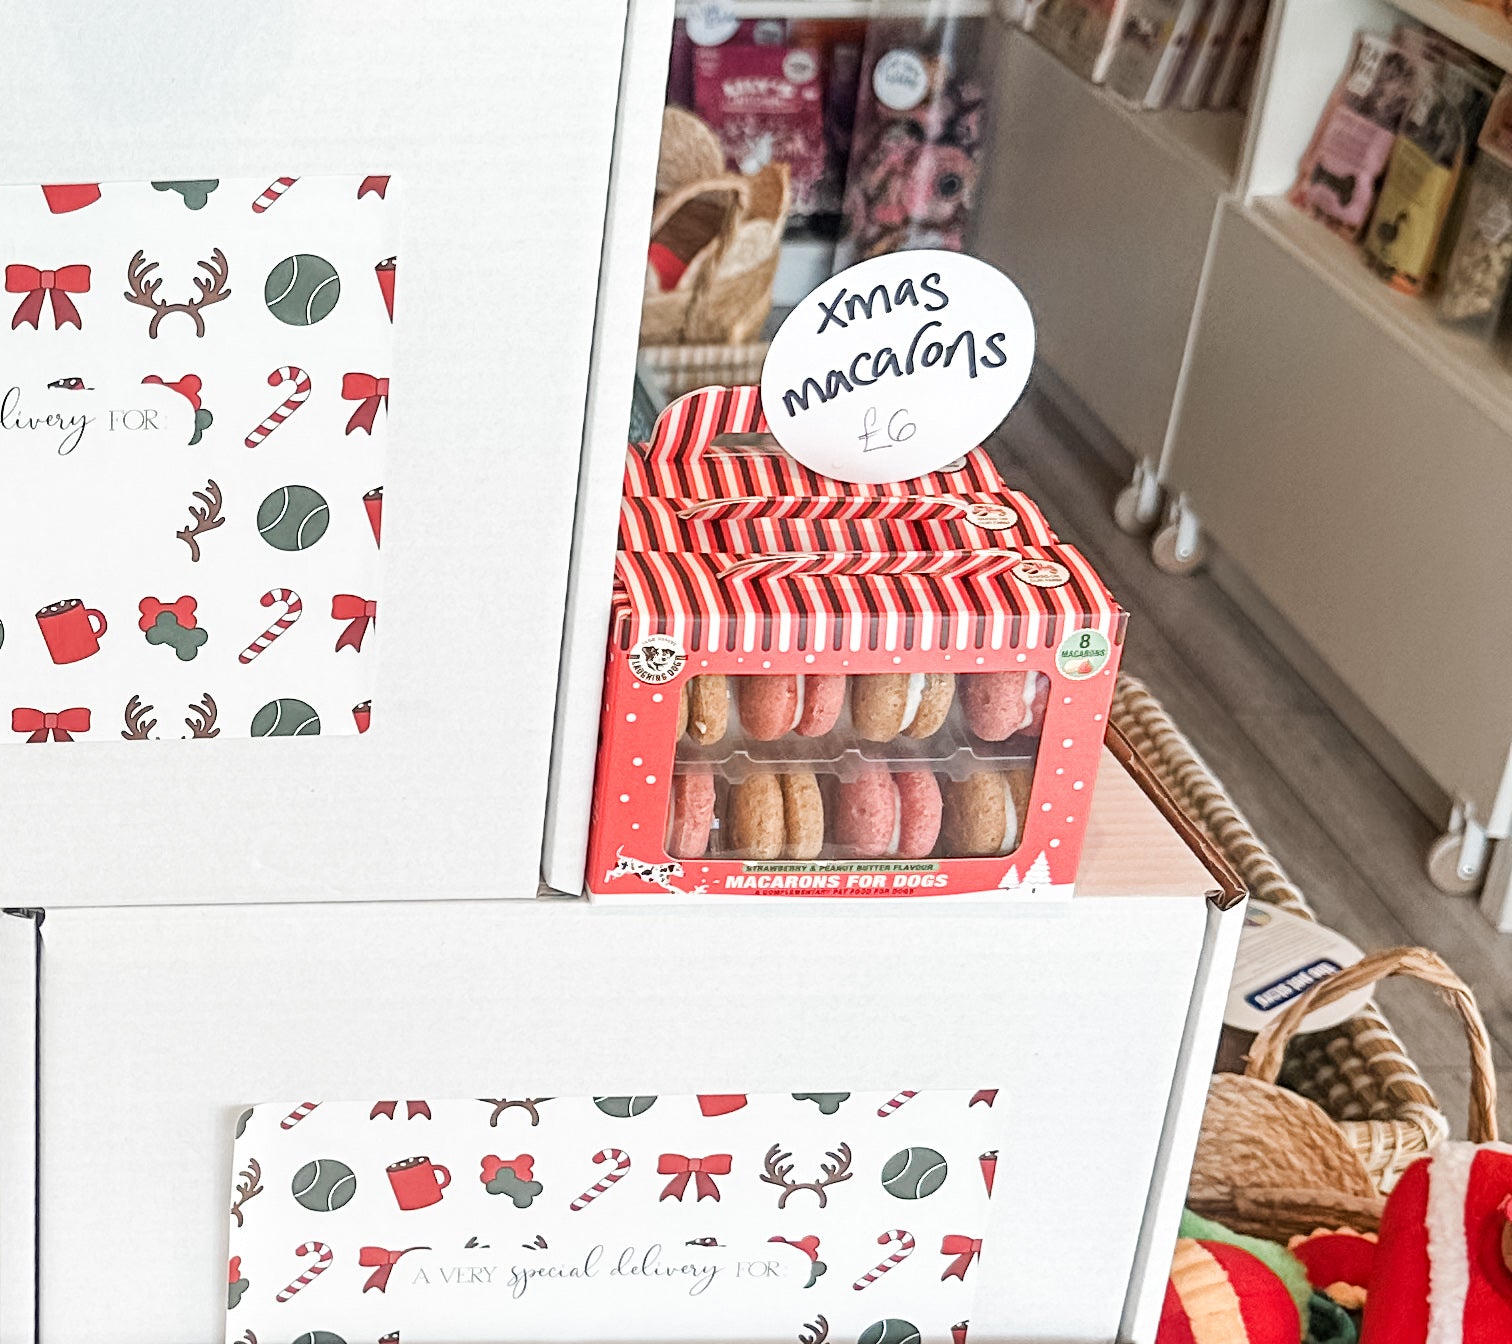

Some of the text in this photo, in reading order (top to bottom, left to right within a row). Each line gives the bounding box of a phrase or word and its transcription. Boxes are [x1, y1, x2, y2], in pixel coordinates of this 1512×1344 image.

[817, 272, 949, 334] xmas
[782, 321, 1007, 417] macarons
[858, 406, 917, 453] £6
[1061, 649, 1106, 658] MACARONS
[1079, 633, 1091, 649] 8
[725, 873, 949, 888] MACARONS FOR DOGS
[746, 864, 807, 872] STRAWBERRY
[818, 864, 854, 872] PEANUT
[856, 864, 891, 872] BUTTER
[439, 1265, 498, 1283] VERY
[507, 1245, 604, 1299] special
[610, 1244, 726, 1296] delivery
